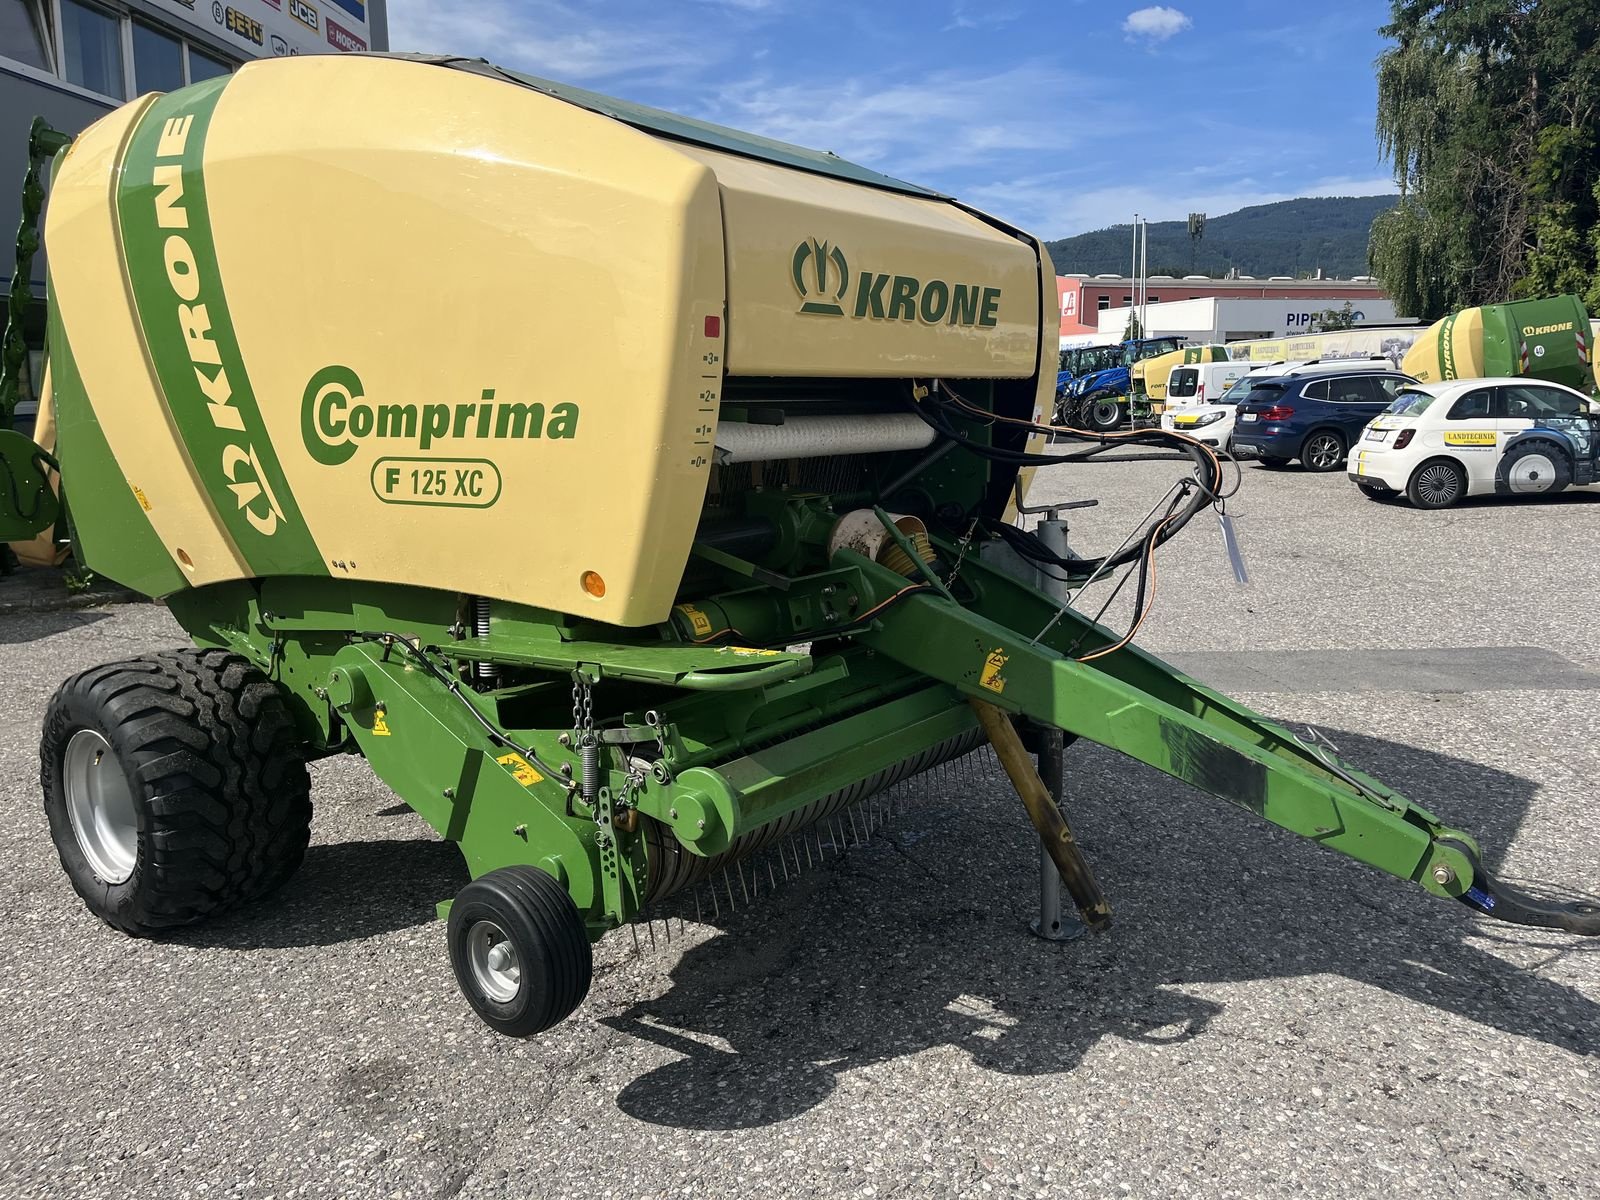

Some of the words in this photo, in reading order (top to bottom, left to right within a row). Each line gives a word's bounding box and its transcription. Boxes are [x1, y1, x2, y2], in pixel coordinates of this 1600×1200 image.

[290, 0, 318, 29] JCB
[152, 114, 247, 432] KRONE
[853, 270, 1001, 328] KRONE
[1535, 321, 1573, 335] KRONE
[1443, 319, 1453, 370] KRONE
[1535, 346, 1544, 355] 40
[1150, 383, 1166, 391] FORT
[301, 365, 580, 466] Comprima
[1448, 433, 1495, 441] LANDTECHNIK
[385, 468, 401, 493] F
[410, 469, 447, 495] 125
[453, 469, 483, 497] XC
